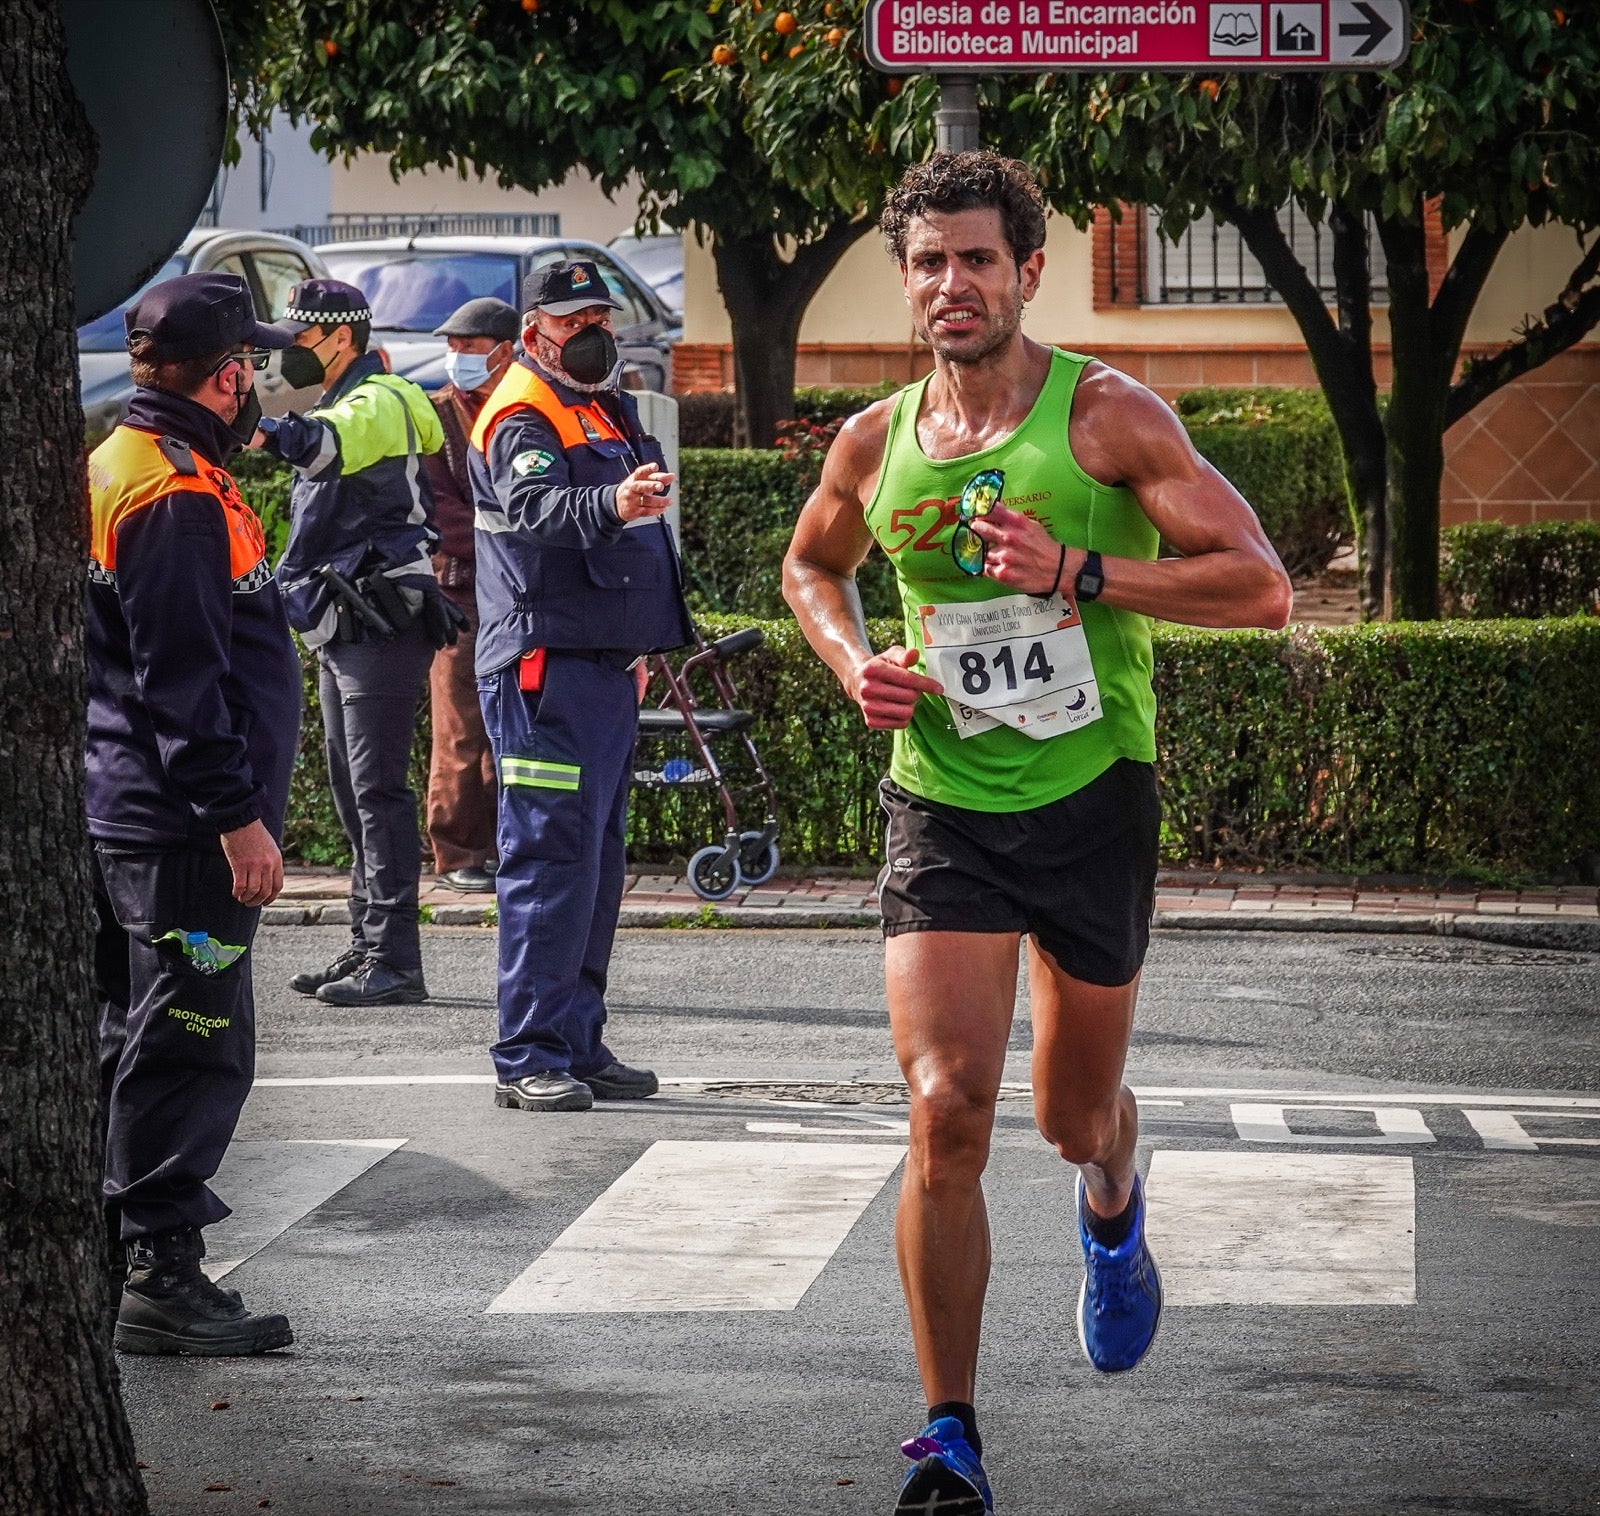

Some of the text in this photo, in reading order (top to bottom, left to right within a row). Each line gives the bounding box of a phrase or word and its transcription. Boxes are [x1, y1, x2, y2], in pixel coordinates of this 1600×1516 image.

[893, 0, 1196, 29] Iglesia de la Encarnación
[892, 30, 1139, 58] Biblioteca Municipal
[1033, 599, 1056, 614] 2022
[959, 641, 1055, 695] 814
[167, 1007, 230, 1029] PROTECCIÓN
[185, 1022, 210, 1038] CIVIL
